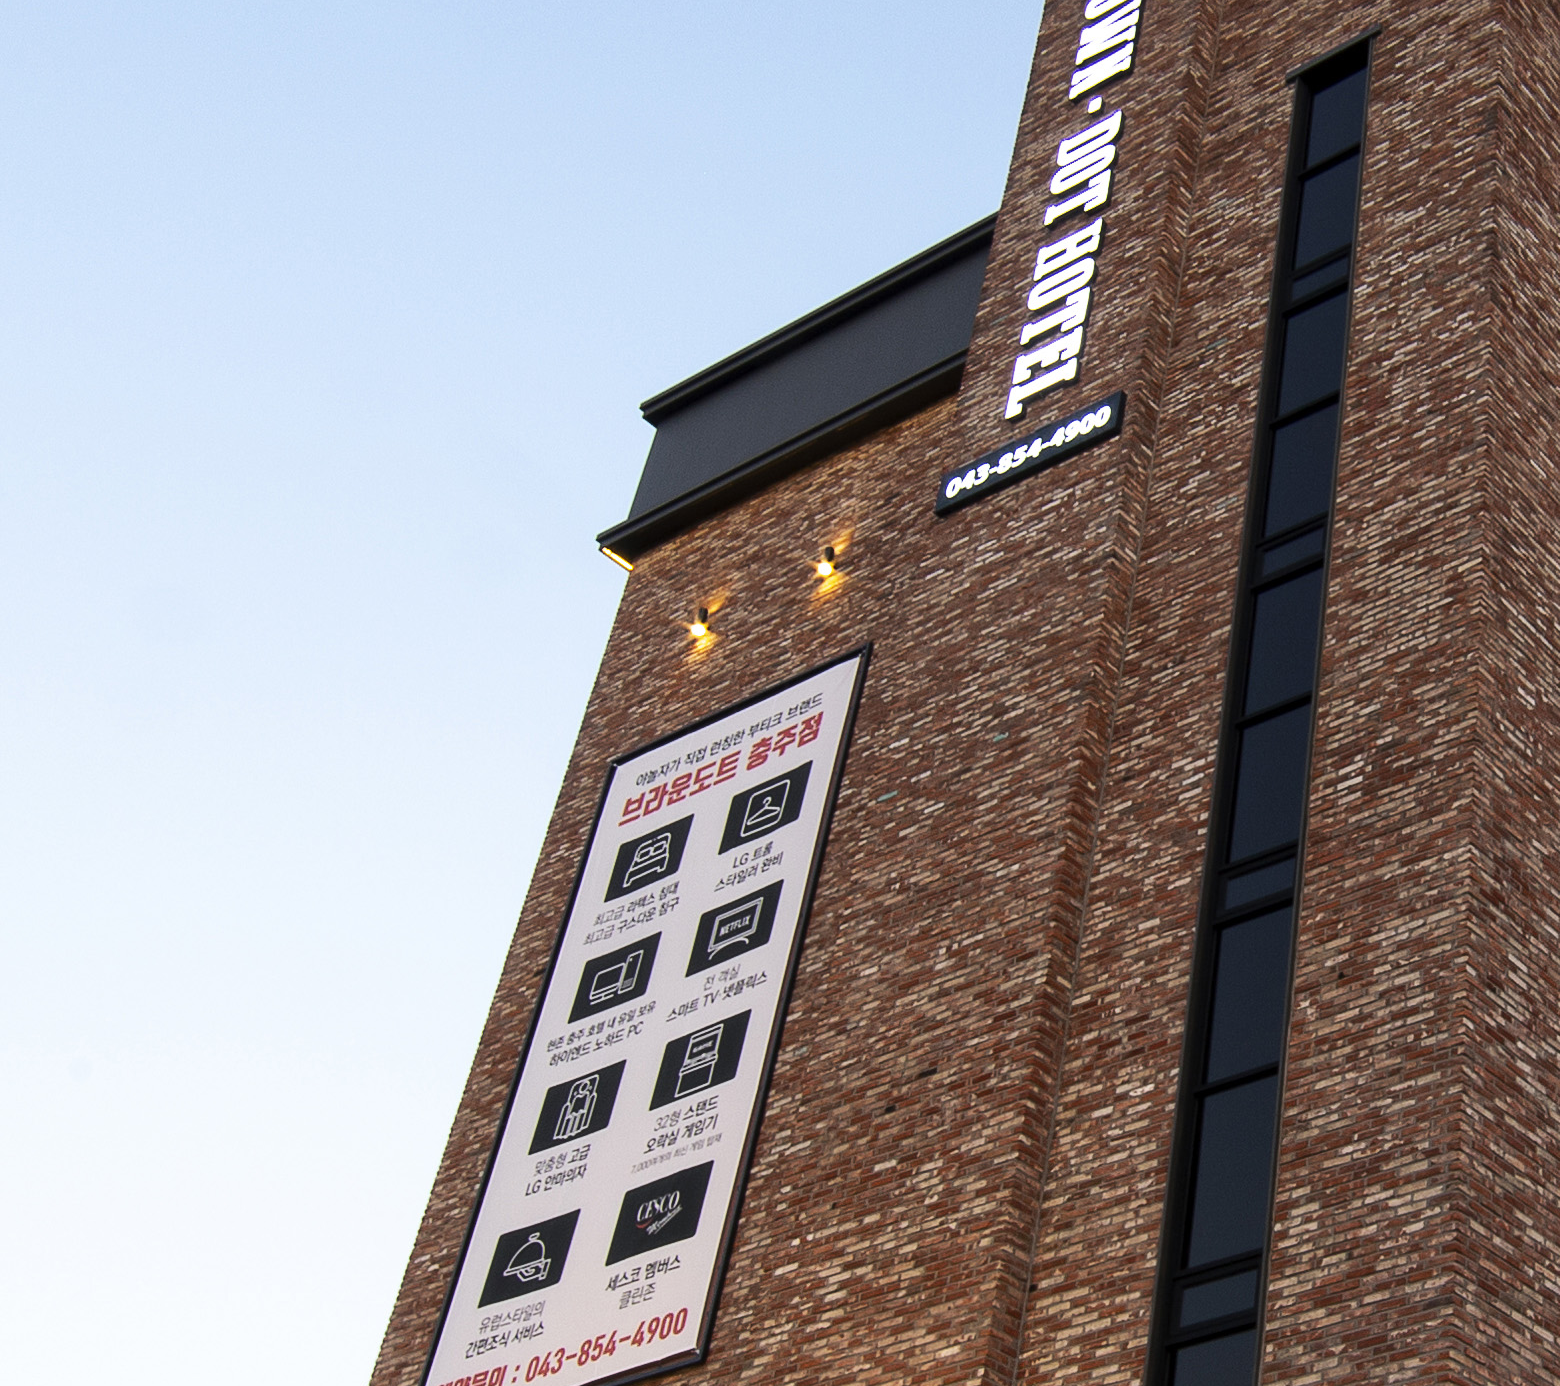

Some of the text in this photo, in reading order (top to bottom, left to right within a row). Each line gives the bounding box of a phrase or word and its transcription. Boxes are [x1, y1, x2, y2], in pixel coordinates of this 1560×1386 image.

[1043, 108, 1123, 227] DOT
[1003, 216, 1104, 421] HOTEL
[943, 404, 1113, 501] 043-854-4900
[684, 746, 707, 769] 직접
[747, 712, 782, 740] 부티크
[785, 692, 823, 721] 브랜드
[618, 710, 824, 826] 브라운도트 충주점
[733, 852, 749, 868] LG
[714, 863, 759, 892] 스타일러
[617, 906, 656, 933] 구스다운
[719, 915, 751, 936] NETFLIX
[718, 963, 741, 983] 객실
[666, 997, 700, 1022] 스마트
[627, 1020, 644, 1039] PC
[682, 1094, 719, 1121] 스탠드
[643, 1113, 719, 1154] 오락실 게임기
[568, 1144, 591, 1163] 고급
[525, 1163, 588, 1196] LG 안마의자
[637, 1190, 680, 1221] CESCO
[605, 1254, 681, 1292] 세스코 멤버스
[618, 1282, 656, 1310] 클린존
[478, 1300, 546, 1334] 유럽스타일의
[465, 1321, 545, 1360] 간편조식 서비스
[525, 1307, 689, 1383] 043-854-4900
